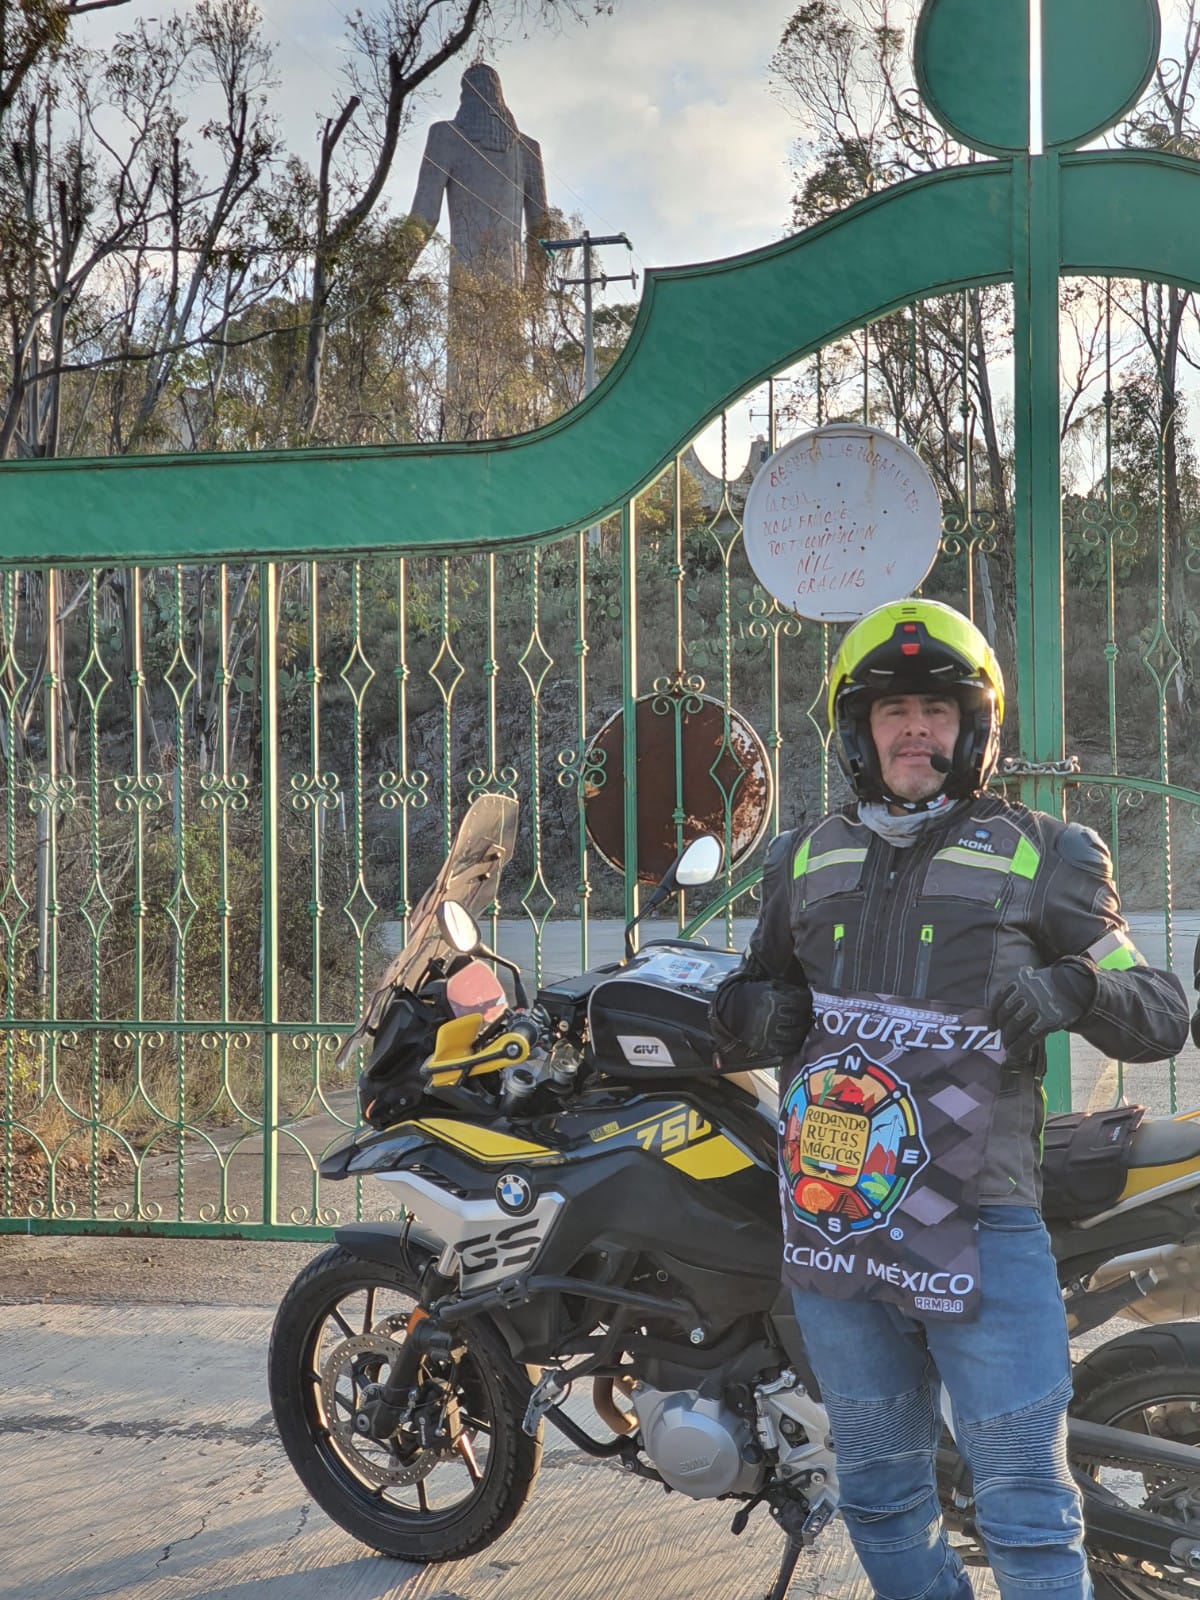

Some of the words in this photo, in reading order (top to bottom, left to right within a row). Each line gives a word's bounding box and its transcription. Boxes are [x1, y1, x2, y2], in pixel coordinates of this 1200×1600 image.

[958, 837, 995, 854] KOHL
[633, 1044, 659, 1055] GIVI
[844, 1055, 861, 1071] N
[902, 1149, 920, 1164] E
[828, 1217, 841, 1232] S
[453, 1218, 541, 1275] GS
[866, 1258, 975, 1295] MÉXICO
